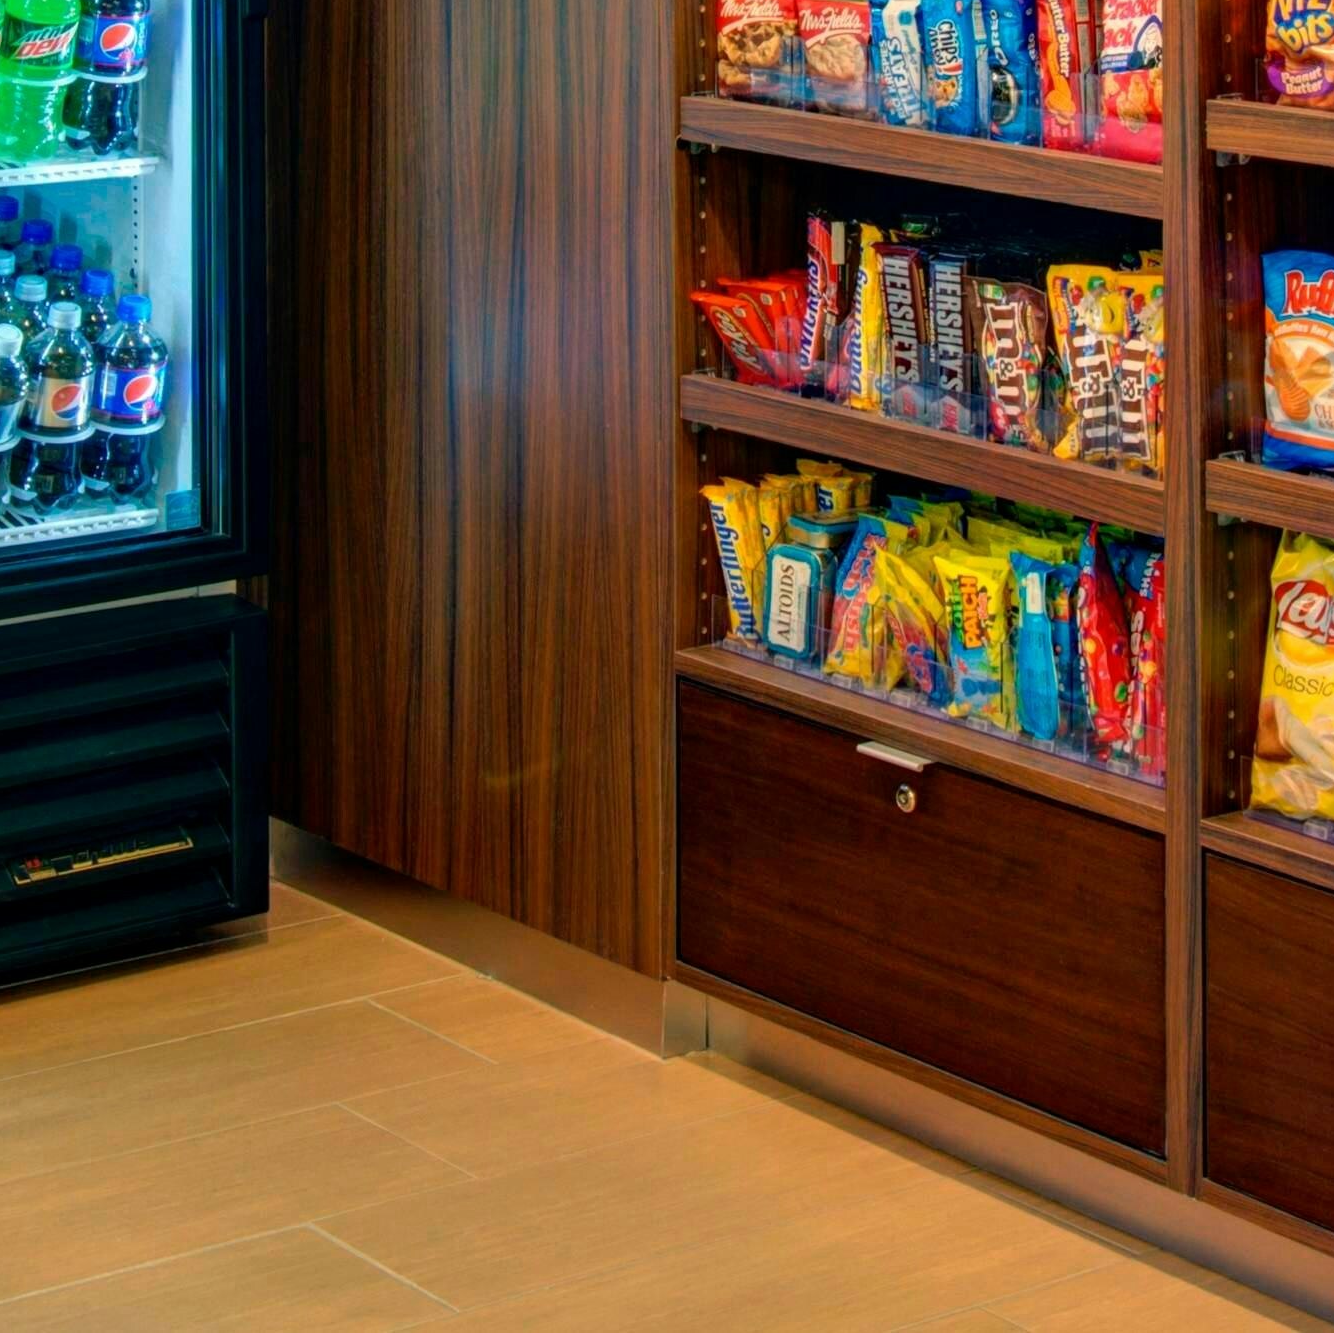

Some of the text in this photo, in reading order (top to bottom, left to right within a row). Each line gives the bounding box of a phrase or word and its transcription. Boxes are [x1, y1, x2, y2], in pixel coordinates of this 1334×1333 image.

[937, 20, 959, 64] Chips
[989, 9, 1008, 65] OREO
[1056, 34, 1072, 77] Butter
[888, 37, 918, 120] TREATS
[1281, 66, 1322, 85] Peanut
[883, 255, 918, 383] HERSHEY'S
[936, 264, 964, 391] HERSHEY'S
[777, 563, 796, 643] ALTOIDS
[958, 574, 982, 649] PATCH
[1273, 664, 1334, 697] Classic
